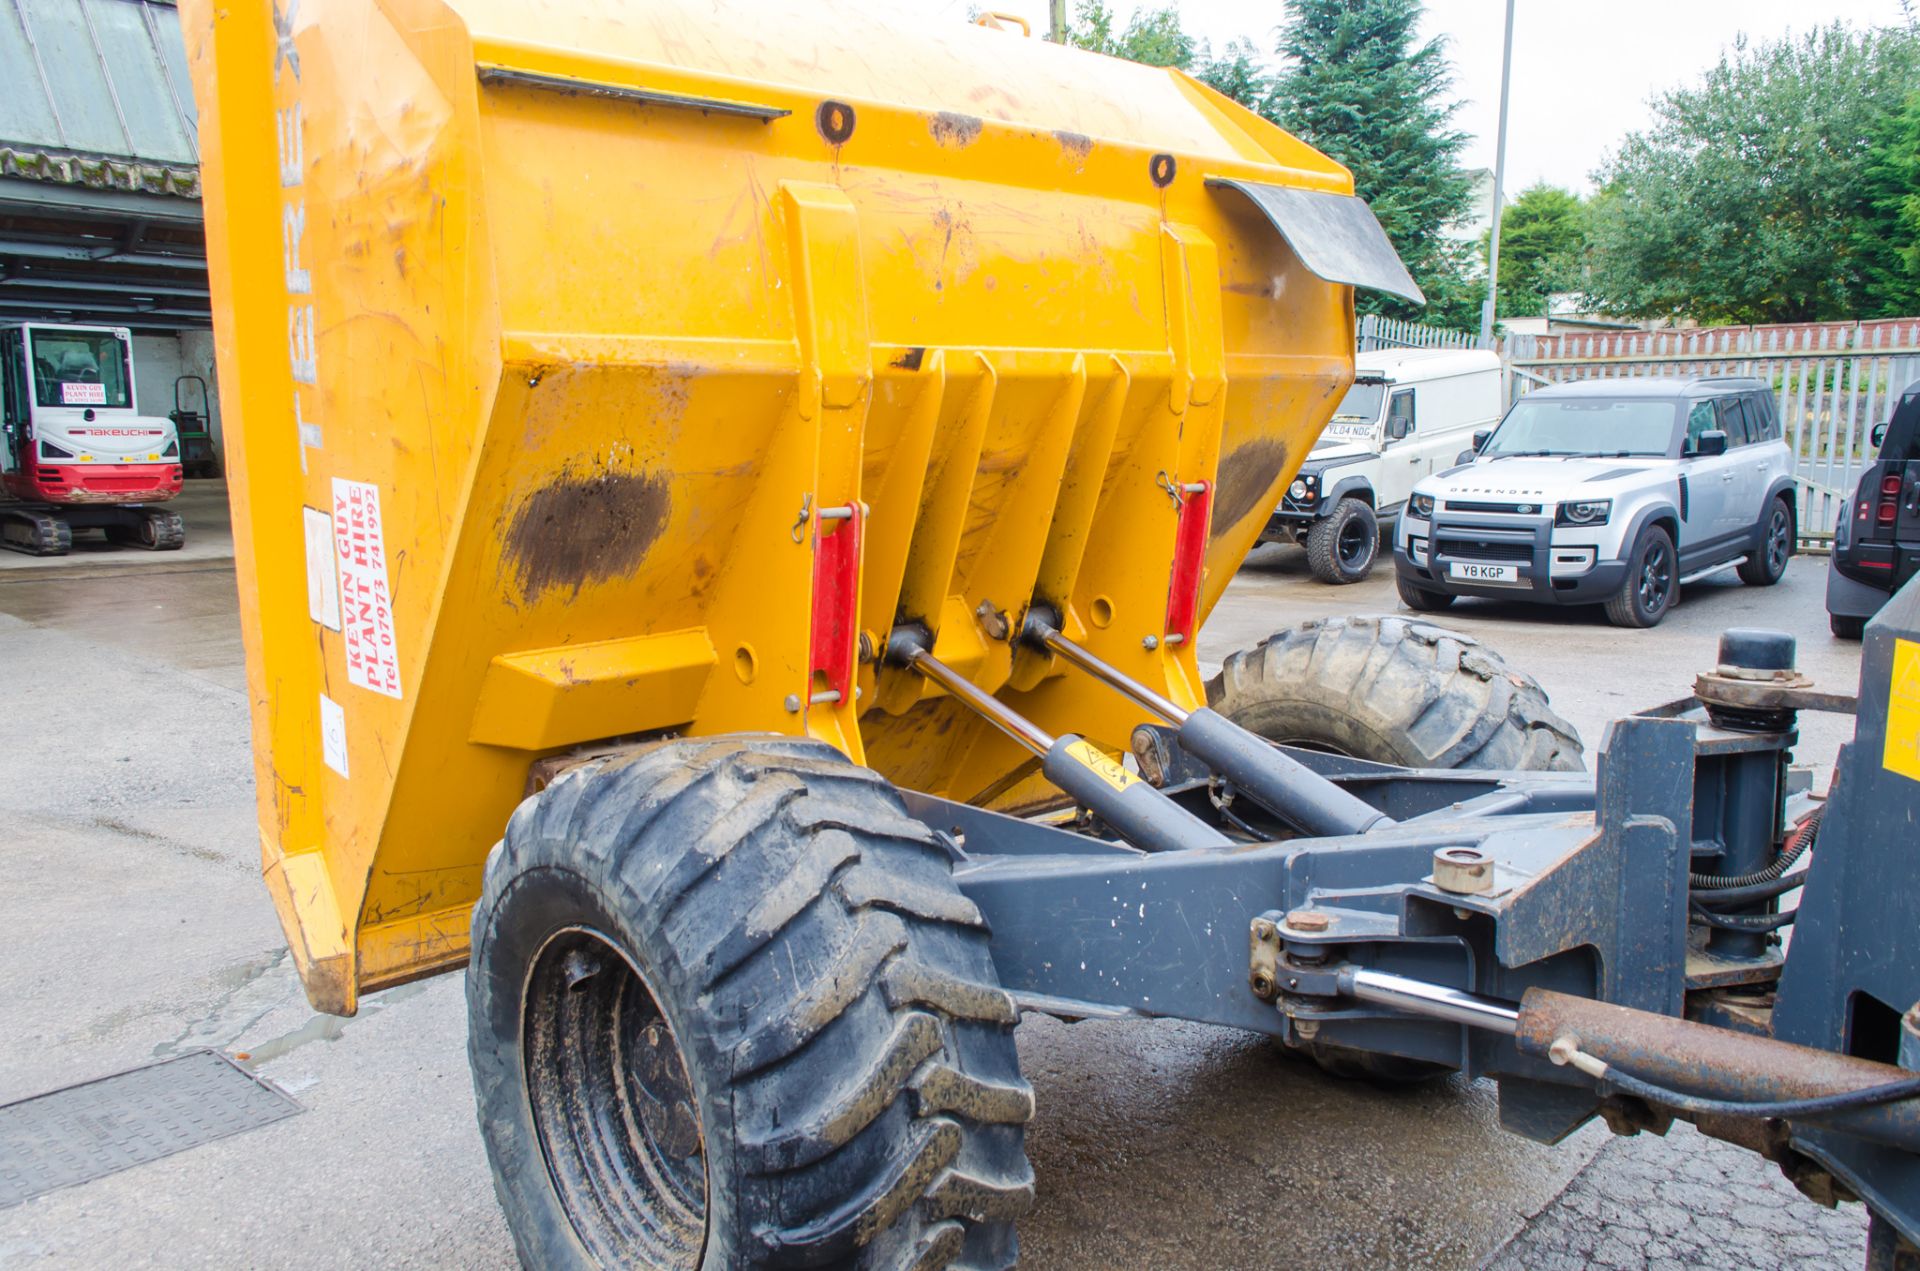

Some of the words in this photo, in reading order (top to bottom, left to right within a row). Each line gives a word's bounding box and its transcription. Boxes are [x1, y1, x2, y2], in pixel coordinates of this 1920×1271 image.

[273, 0, 323, 476] TEREX
[336, 494, 352, 560] GUY
[349, 486, 368, 567] HIRE
[1450, 487, 1544, 496] DEFENDER
[365, 489, 383, 570] 741992
[1463, 565, 1478, 577] Y8
[1480, 566, 1504, 579] KGP
[342, 571, 362, 670] KEVIN
[357, 577, 382, 689] PLANT
[374, 578, 392, 647] 07973
[384, 655, 398, 692] Tel.
